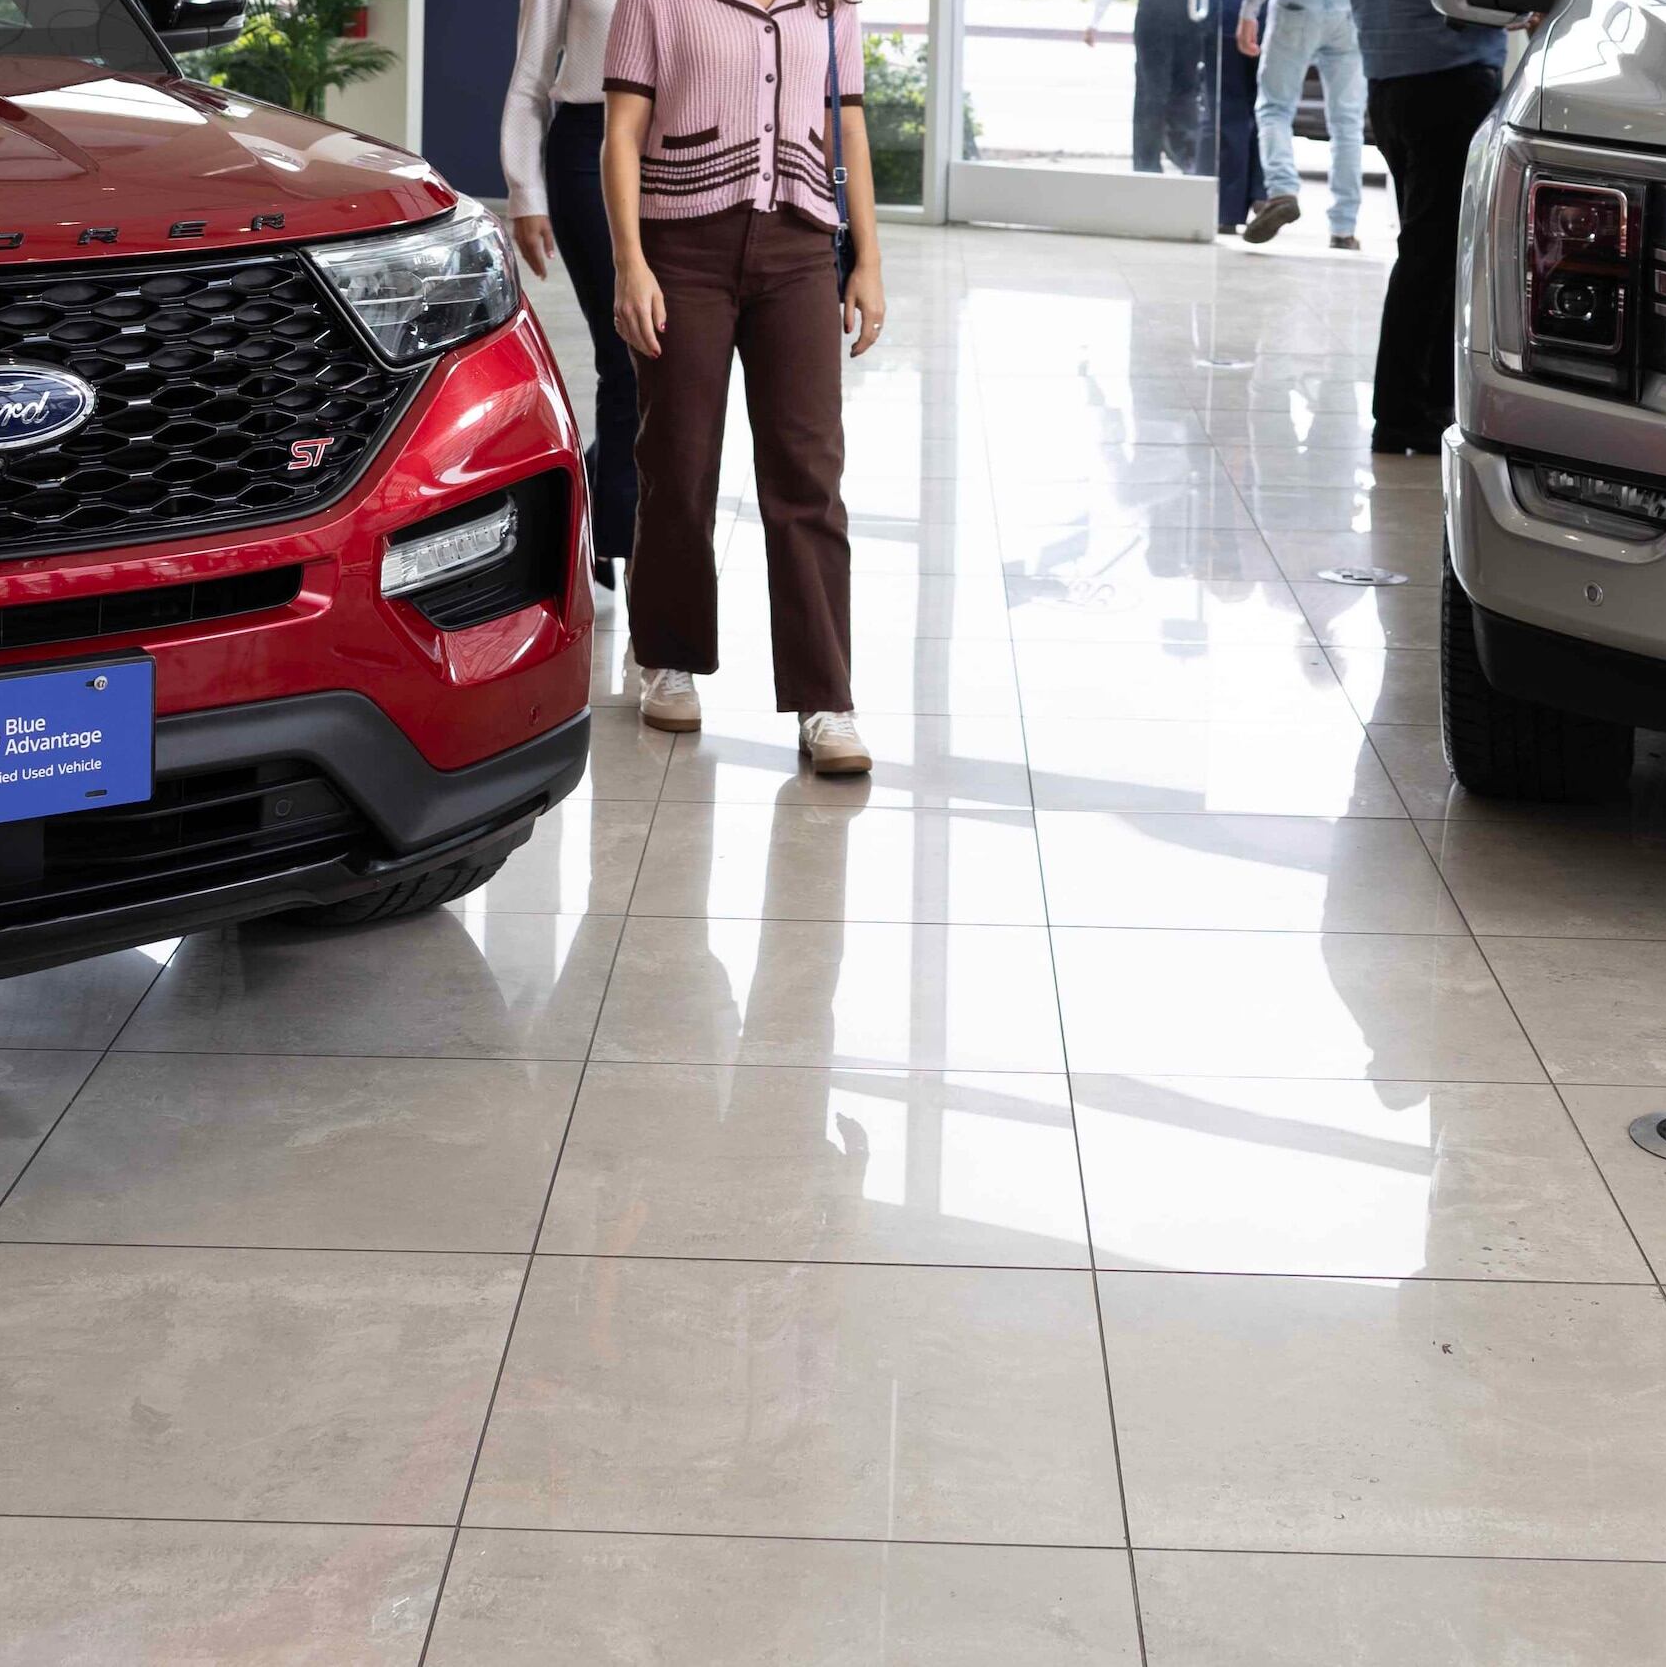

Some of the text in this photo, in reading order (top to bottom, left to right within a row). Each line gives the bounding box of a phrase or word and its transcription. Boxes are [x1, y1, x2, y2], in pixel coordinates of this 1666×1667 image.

[287, 437, 335, 470] ST
[5, 717, 46, 736] Blue
[4, 728, 102, 756] Advantage
[22, 764, 54, 780] Used
[58, 758, 102, 775] Vehicle
